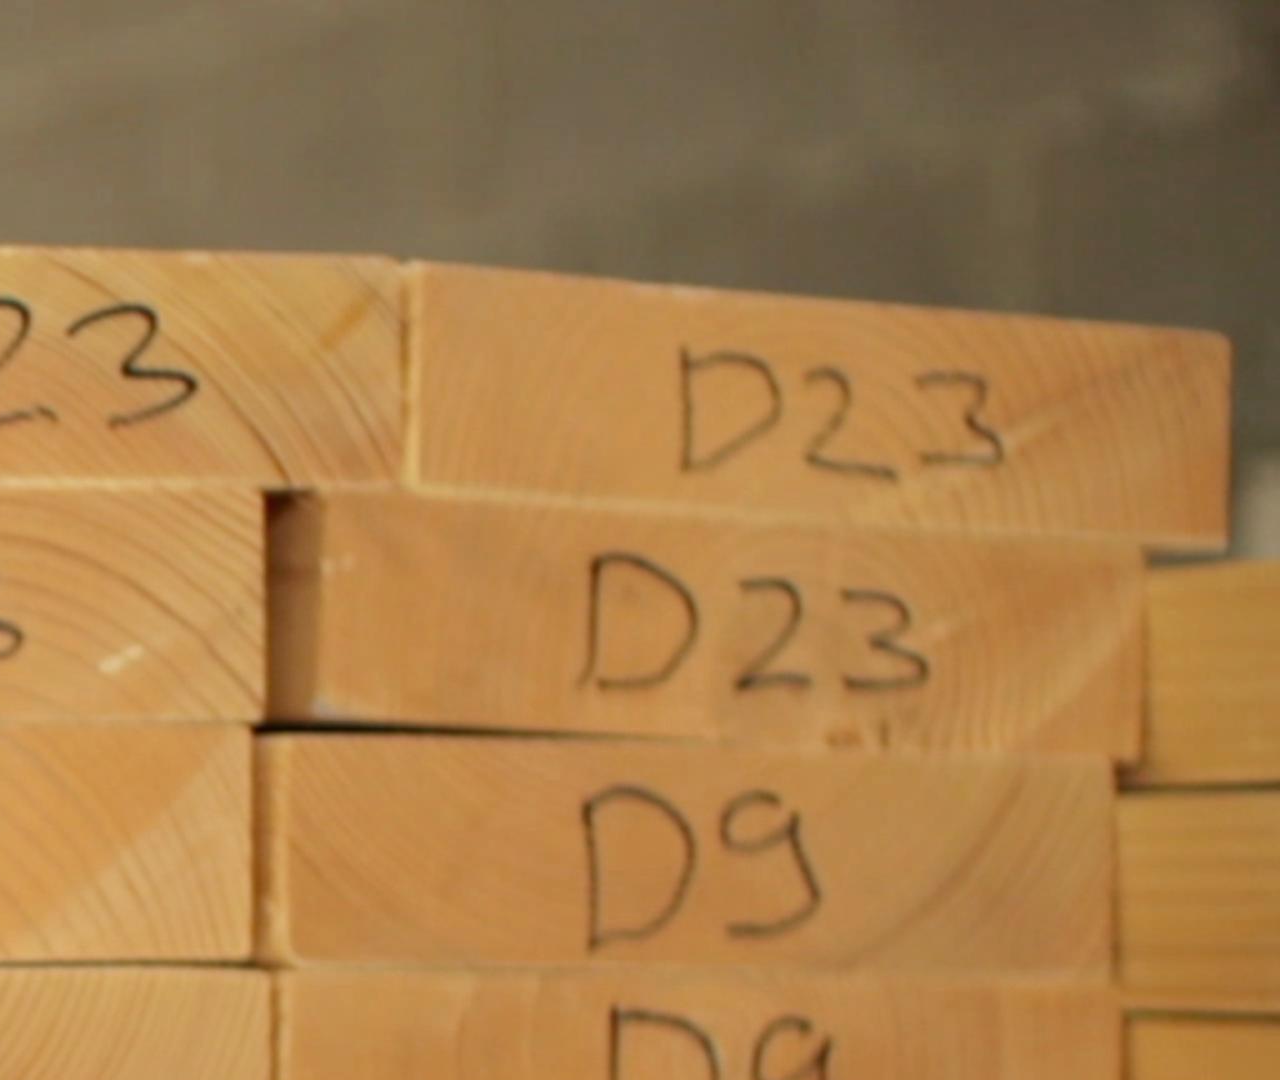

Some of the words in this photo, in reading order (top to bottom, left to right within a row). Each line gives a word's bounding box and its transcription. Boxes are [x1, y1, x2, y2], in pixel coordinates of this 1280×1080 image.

[681, 346, 1004, 481] D23
[576, 552, 930, 692] D23
[582, 784, 820, 952] D9
